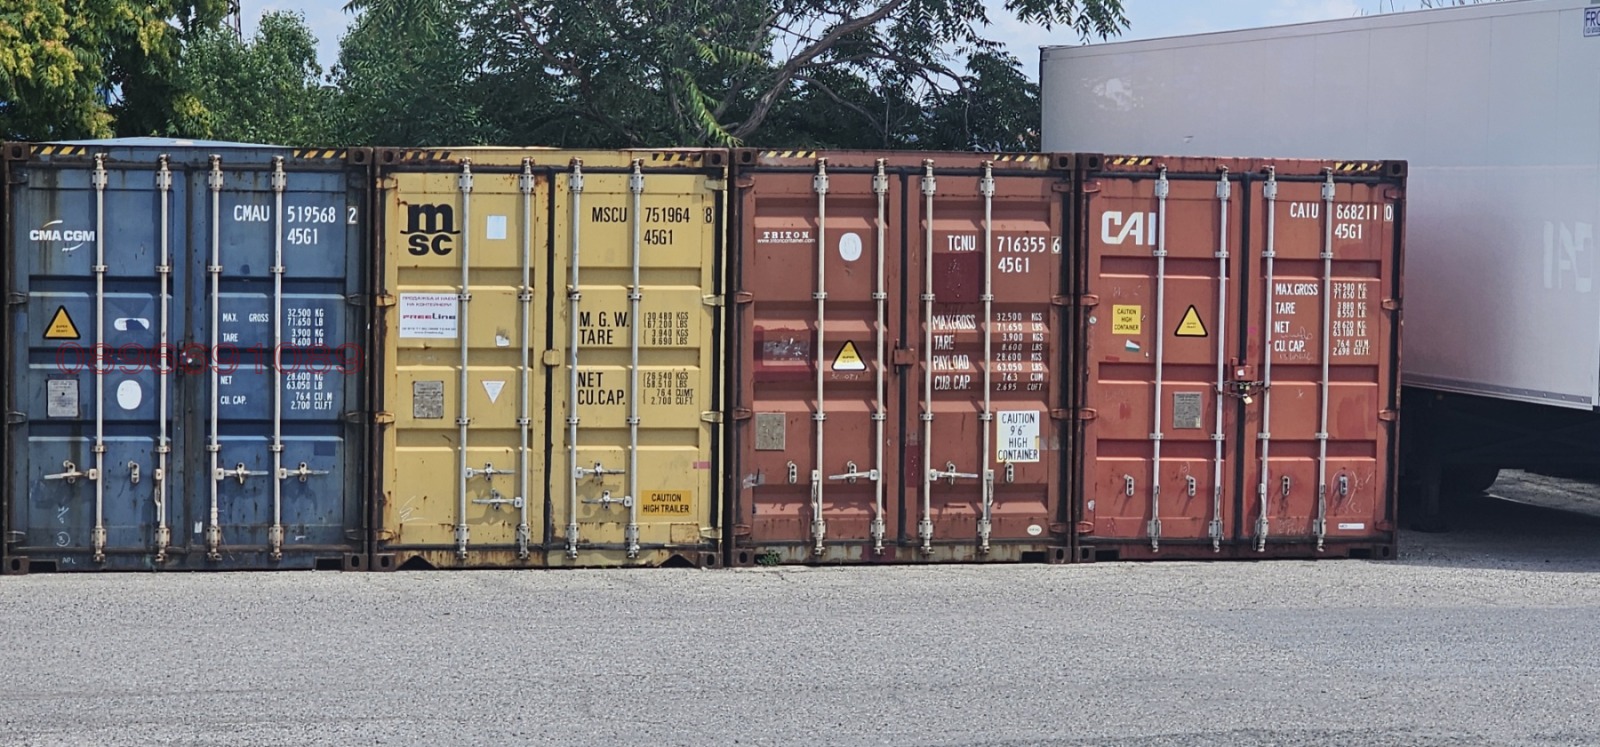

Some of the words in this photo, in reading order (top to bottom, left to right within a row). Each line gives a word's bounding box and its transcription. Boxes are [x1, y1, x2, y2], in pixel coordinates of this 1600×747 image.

[234, 205, 271, 222] CMAU
[287, 206, 336, 223] 519568
[348, 207, 357, 223] 2
[591, 207, 628, 223] MSCU
[644, 207, 691, 223] 751964
[705, 208, 713, 224] 8
[1290, 202, 1320, 218] CAIU
[1385, 205, 1393, 220] 0
[1101, 211, 1157, 246] CAI
[1334, 223, 1363, 240] 45G1
[29, 230, 62, 241] CMA
[63, 230, 96, 242] CGM
[287, 228, 318, 245] 45G1
[643, 229, 674, 245] 45G1
[763, 231, 810, 239] TRITON
[947, 235, 976, 251] TCNU
[997, 236, 1046, 252] 716355
[1052, 237, 1061, 253] 6
[997, 257, 1030, 273] 45G1
[287, 308, 312, 318] 32.500
[314, 308, 324, 318] KG
[1116, 308, 1137, 316] CAUTION
[1275, 302, 1296, 315] TARE
[248, 313, 270, 323] GROSS
[996, 312, 1023, 322] 32.500
[314, 328, 324, 338] KG
[1274, 320, 1290, 334] NET
[223, 333, 238, 342] TARE
[580, 329, 614, 345] TARE
[934, 334, 955, 350] TARE
[1288, 340, 1306, 352] CAP.
[933, 355, 970, 371] PAYLOAD
[220, 375, 233, 385] NET
[577, 371, 604, 388] NET
[1001, 413, 1035, 424] CAUTION
[1008, 437, 1028, 448] HIGH
[998, 449, 1039, 461] CONTAINER
[651, 492, 682, 503] CAUTION
[642, 504, 660, 513] HIGH
[661, 504, 690, 514] TRAILER
